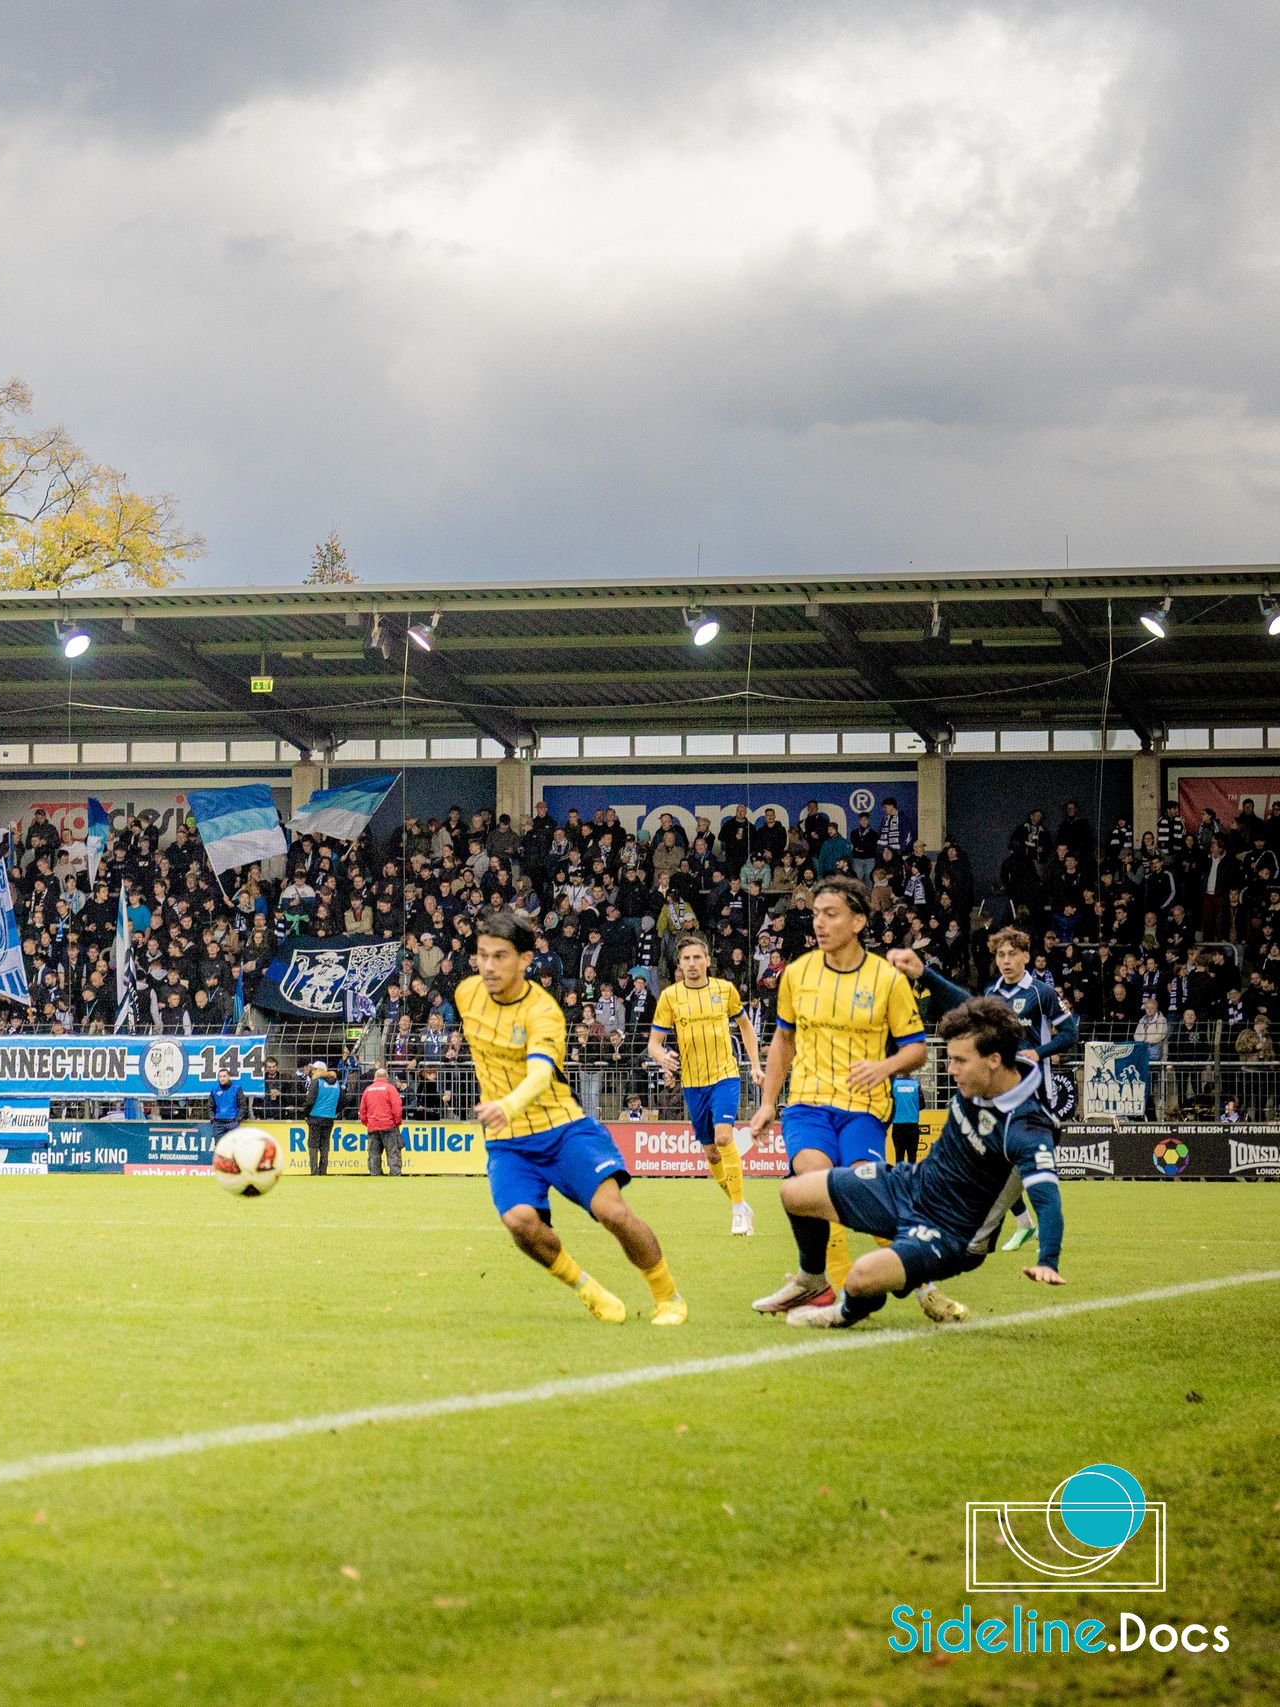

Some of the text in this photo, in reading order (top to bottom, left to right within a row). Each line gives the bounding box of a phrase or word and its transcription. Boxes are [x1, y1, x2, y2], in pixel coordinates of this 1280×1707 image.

[199, 1046, 265, 1080] 144
[1087, 1082, 1145, 1101] VORAN
[61, 1128, 82, 1144] wir
[289, 1127, 370, 1152] Rfen
[1067, 1126, 1085, 1134] HATE
[1086, 1126, 1112, 1134] RACISM
[1120, 1126, 1136, 1134] LOVE
[1138, 1126, 1171, 1134] FOOTBALL
[1178, 1126, 1194, 1134] HATE
[1196, 1126, 1223, 1134] RACISM
[635, 1131, 705, 1153] Potsda
[72, 1147, 91, 1163] ins
[95, 1149, 128, 1164] KINO
[1229, 1139, 1280, 1166] LONSD
[635, 1160, 658, 1170] Deine
[661, 1160, 695, 1172] Energie.
[750, 1160, 773, 1170] Deine
